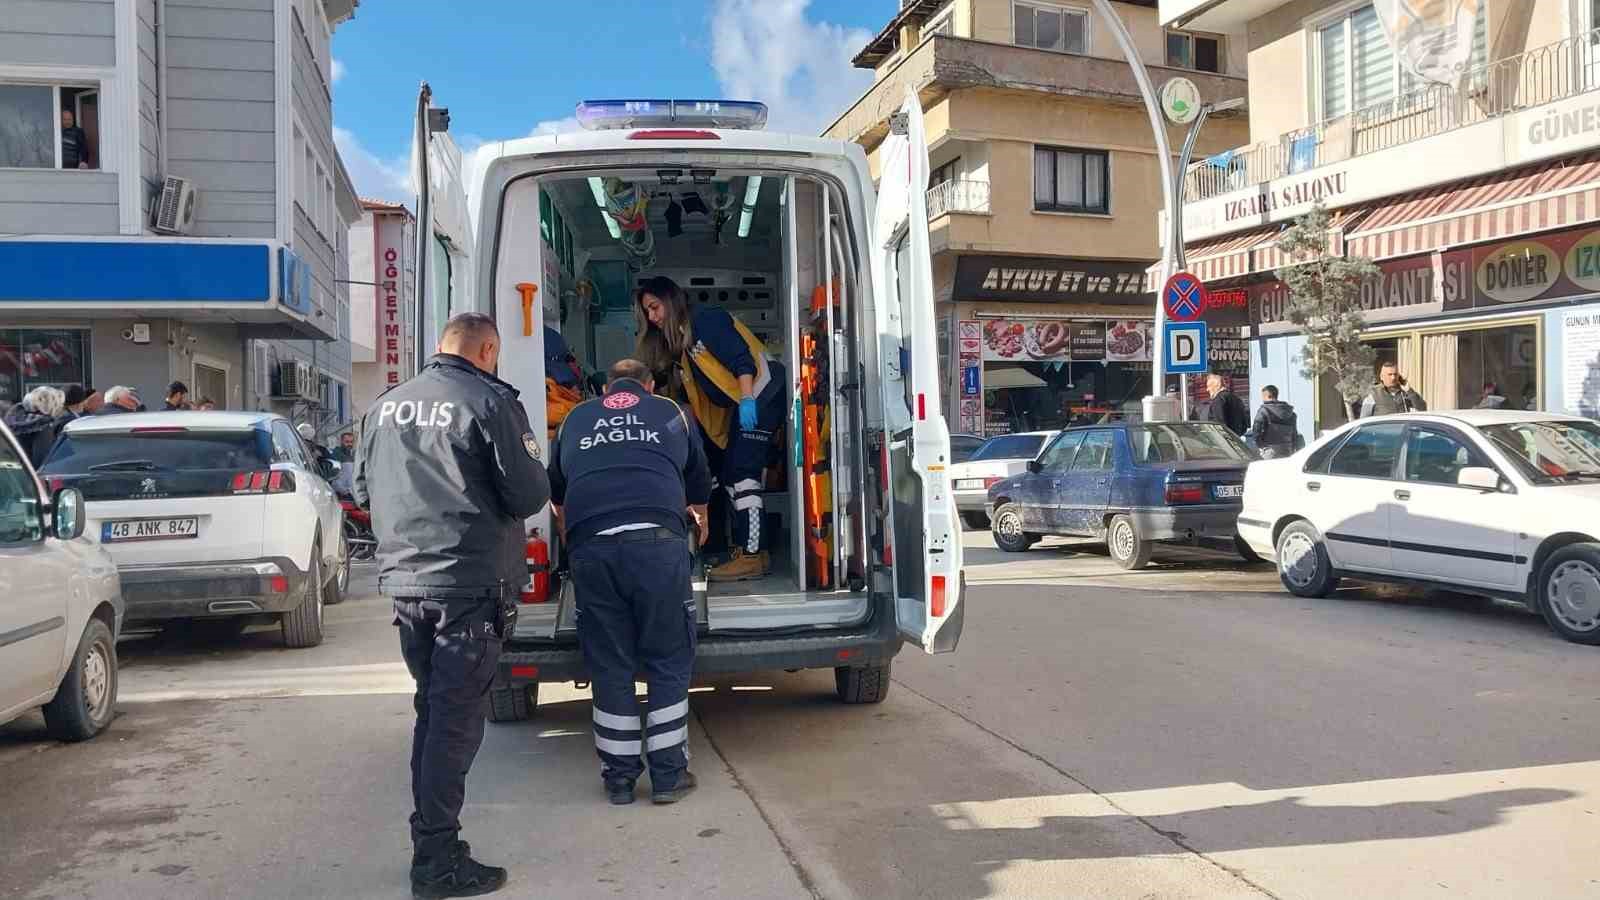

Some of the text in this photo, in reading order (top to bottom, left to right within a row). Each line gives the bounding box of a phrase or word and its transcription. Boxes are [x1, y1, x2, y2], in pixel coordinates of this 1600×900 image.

[1528, 104, 1600, 145] GÜNE
[1225, 191, 1279, 222] IZGARA
[1282, 171, 1347, 208] SALONU
[982, 267, 1057, 292] AYKUT
[1057, 270, 1086, 293] ET
[1486, 251, 1548, 291] DÖNER
[1356, 261, 1467, 311] OKANTASI
[1175, 334, 1194, 361] D
[1207, 349, 1248, 361] ÜNYAS
[593, 413, 645, 430] ACİL
[580, 427, 660, 450] SAĞLIK
[112, 519, 194, 537] 48 ANK 847
